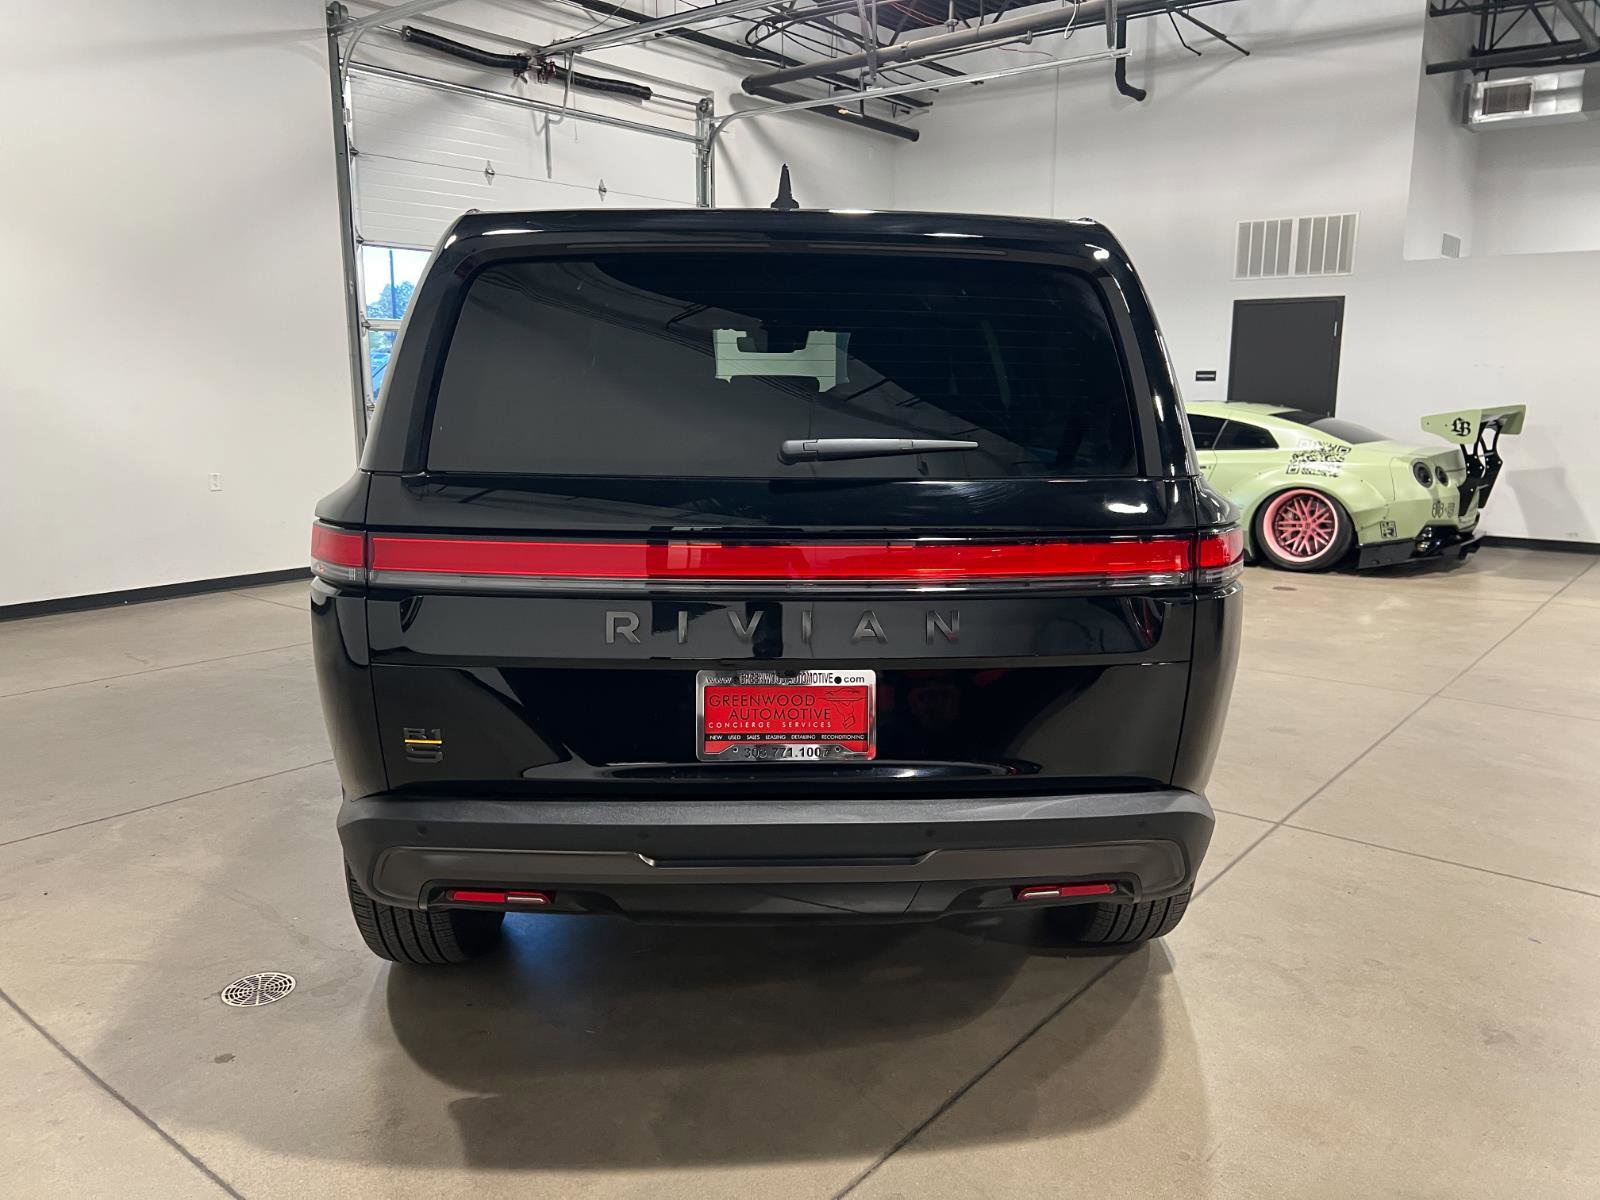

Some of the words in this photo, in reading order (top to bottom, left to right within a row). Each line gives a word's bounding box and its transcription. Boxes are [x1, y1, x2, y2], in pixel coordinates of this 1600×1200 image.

[605, 611, 961, 644] RIVIAN
[709, 694, 816, 707] GREENWOOD
[729, 708, 831, 720] AUTOMOTIVE
[708, 721, 771, 729] CONCIERGE
